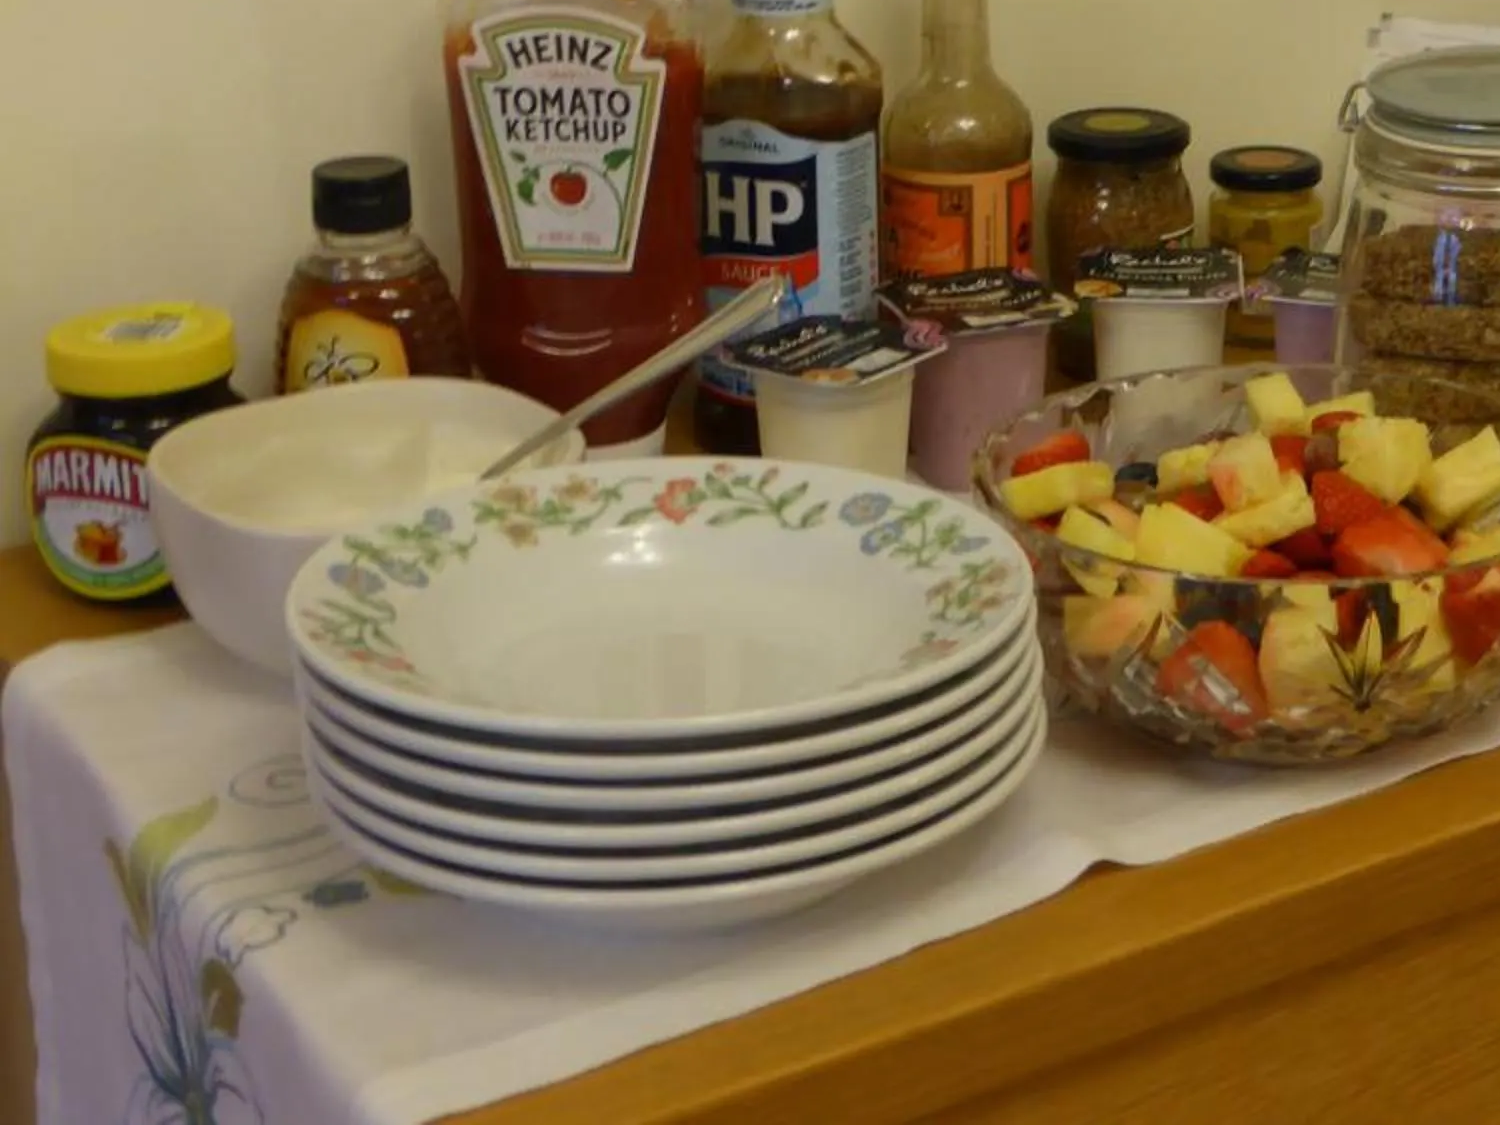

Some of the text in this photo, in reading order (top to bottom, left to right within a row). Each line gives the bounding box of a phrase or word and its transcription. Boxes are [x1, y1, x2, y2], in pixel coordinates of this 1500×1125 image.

[506, 33, 613, 72] HEINZ
[494, 86, 631, 118] TOMATO
[505, 117, 626, 144] KETCHUP
[706, 170, 804, 247] HP
[35, 449, 149, 505] MARMIT
